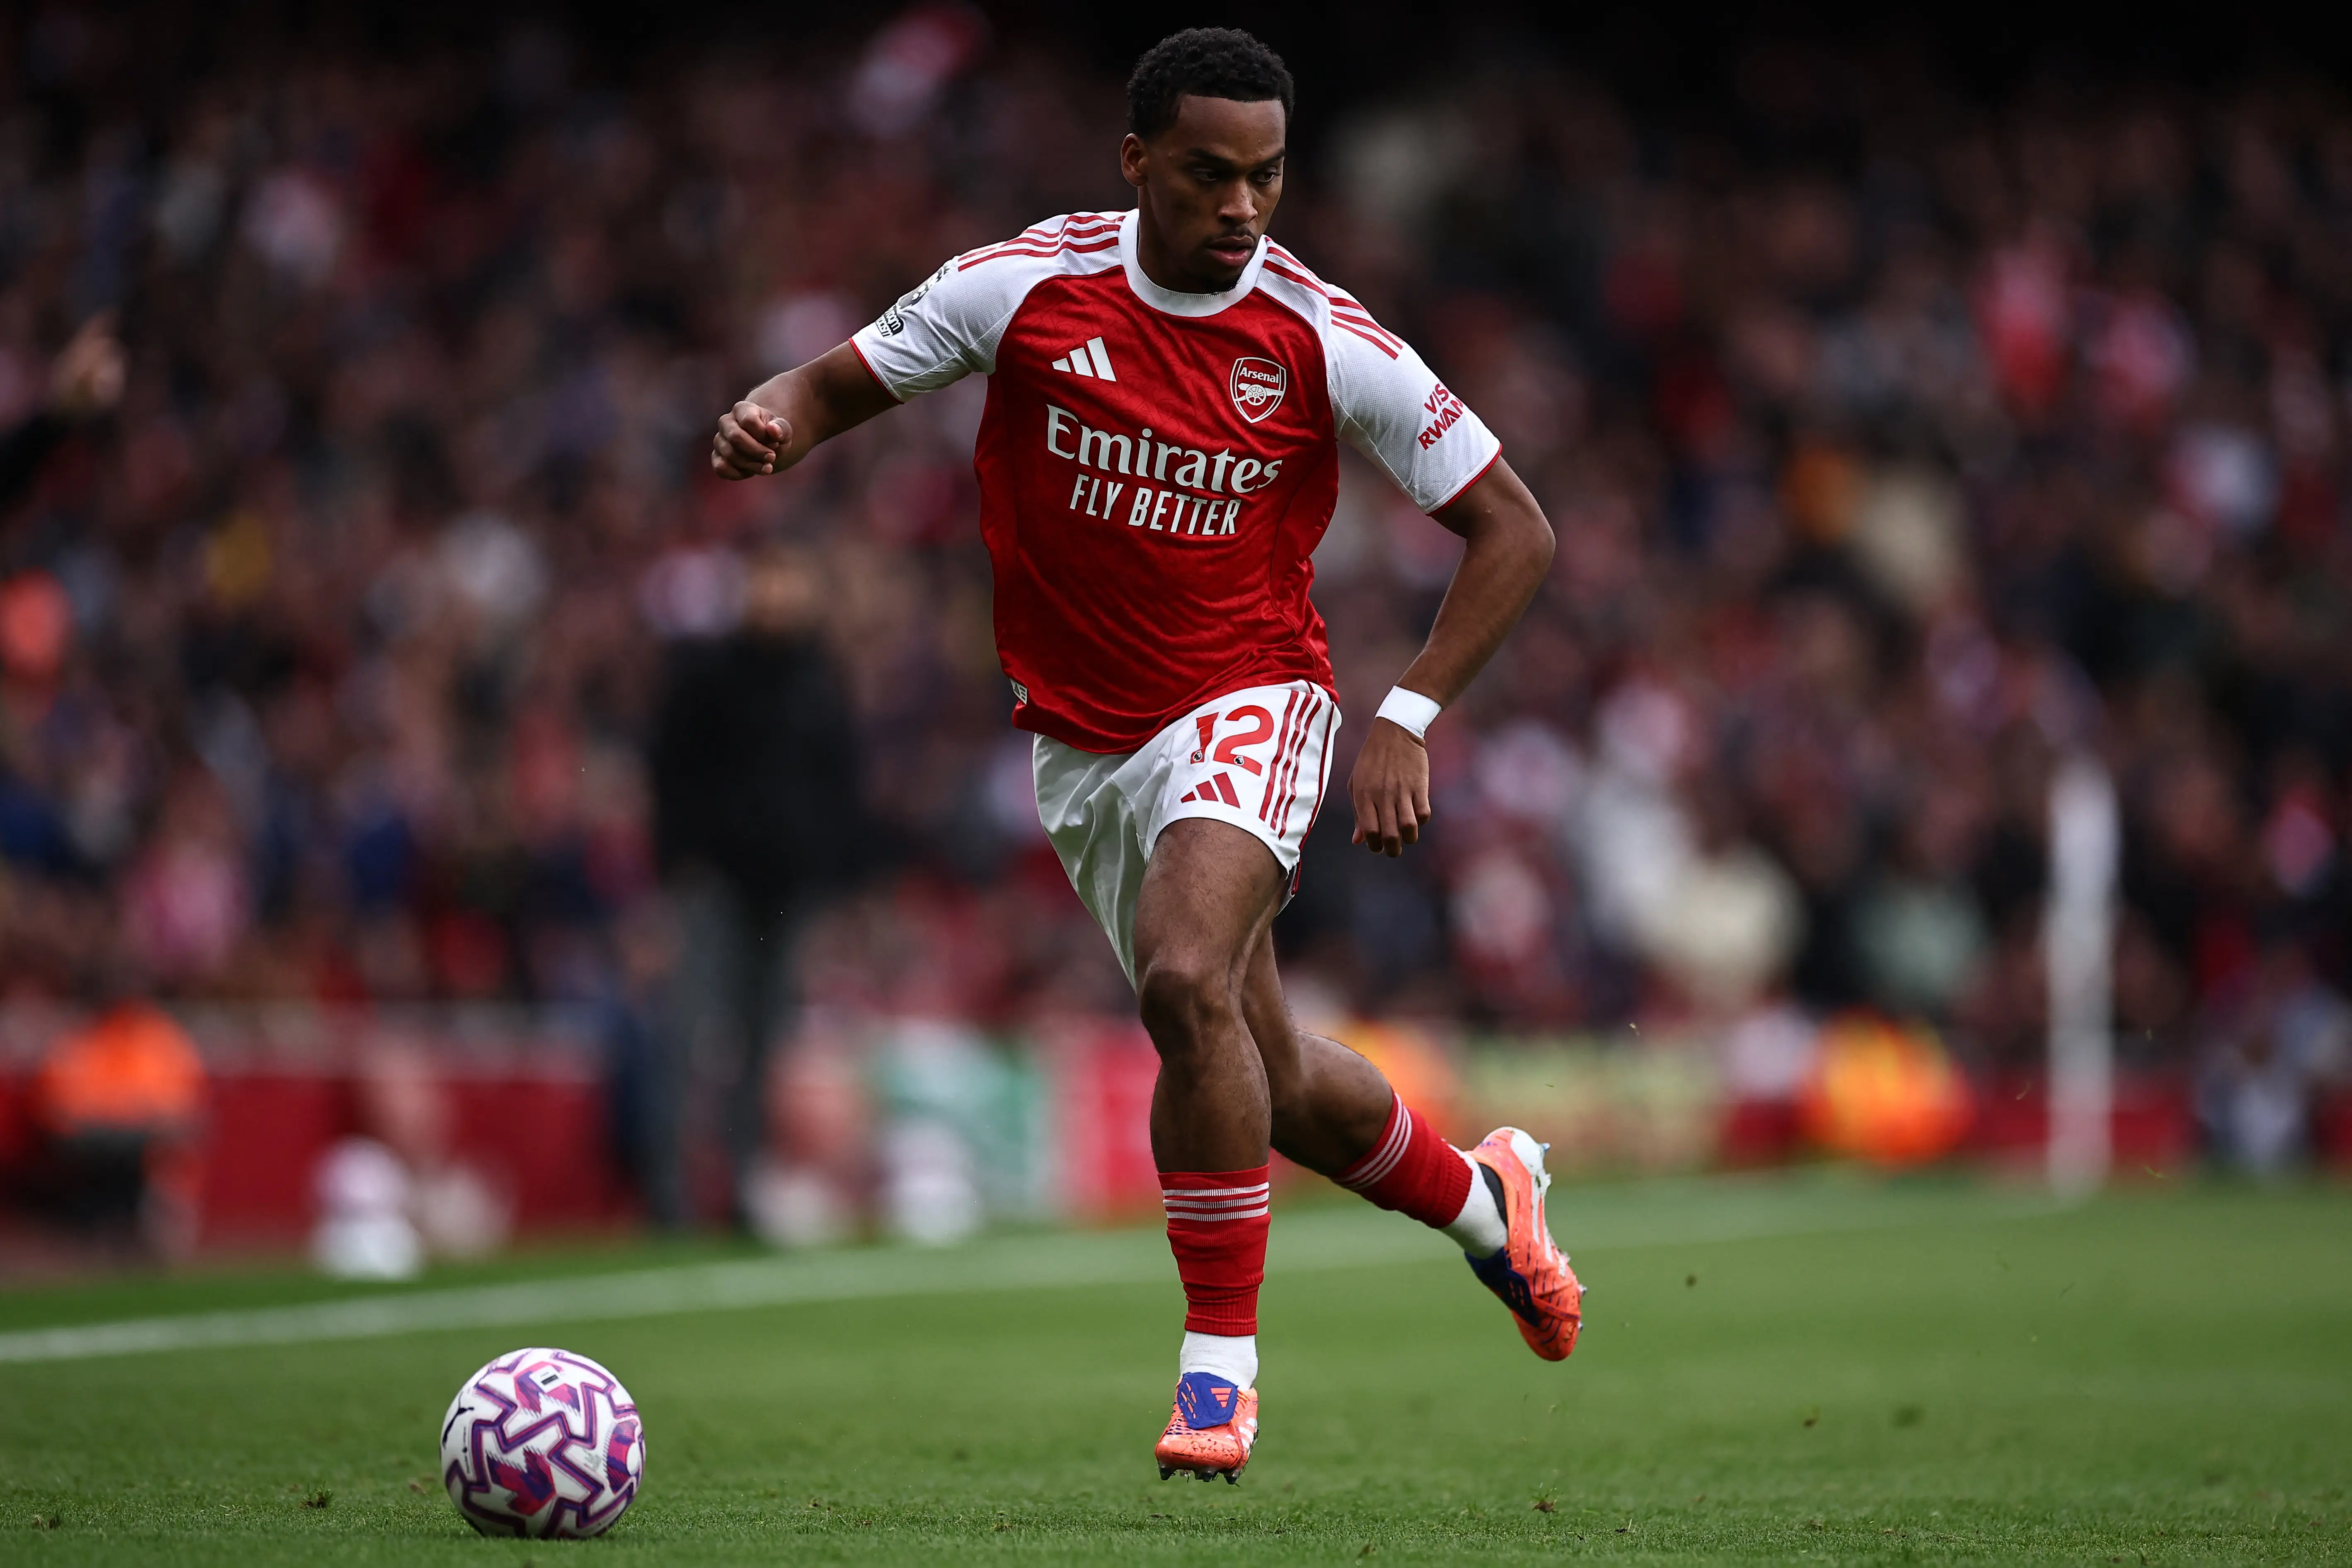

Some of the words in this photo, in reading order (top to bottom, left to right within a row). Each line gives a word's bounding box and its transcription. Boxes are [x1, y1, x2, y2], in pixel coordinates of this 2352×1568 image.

[1239, 367, 1279, 383] Arsenal
[1424, 382, 1450, 414] VIS
[1046, 404, 1282, 493] Emirates
[1070, 474, 1124, 520] FLY
[1128, 487, 1241, 535] BETTER
[1190, 705, 1274, 777] 12
